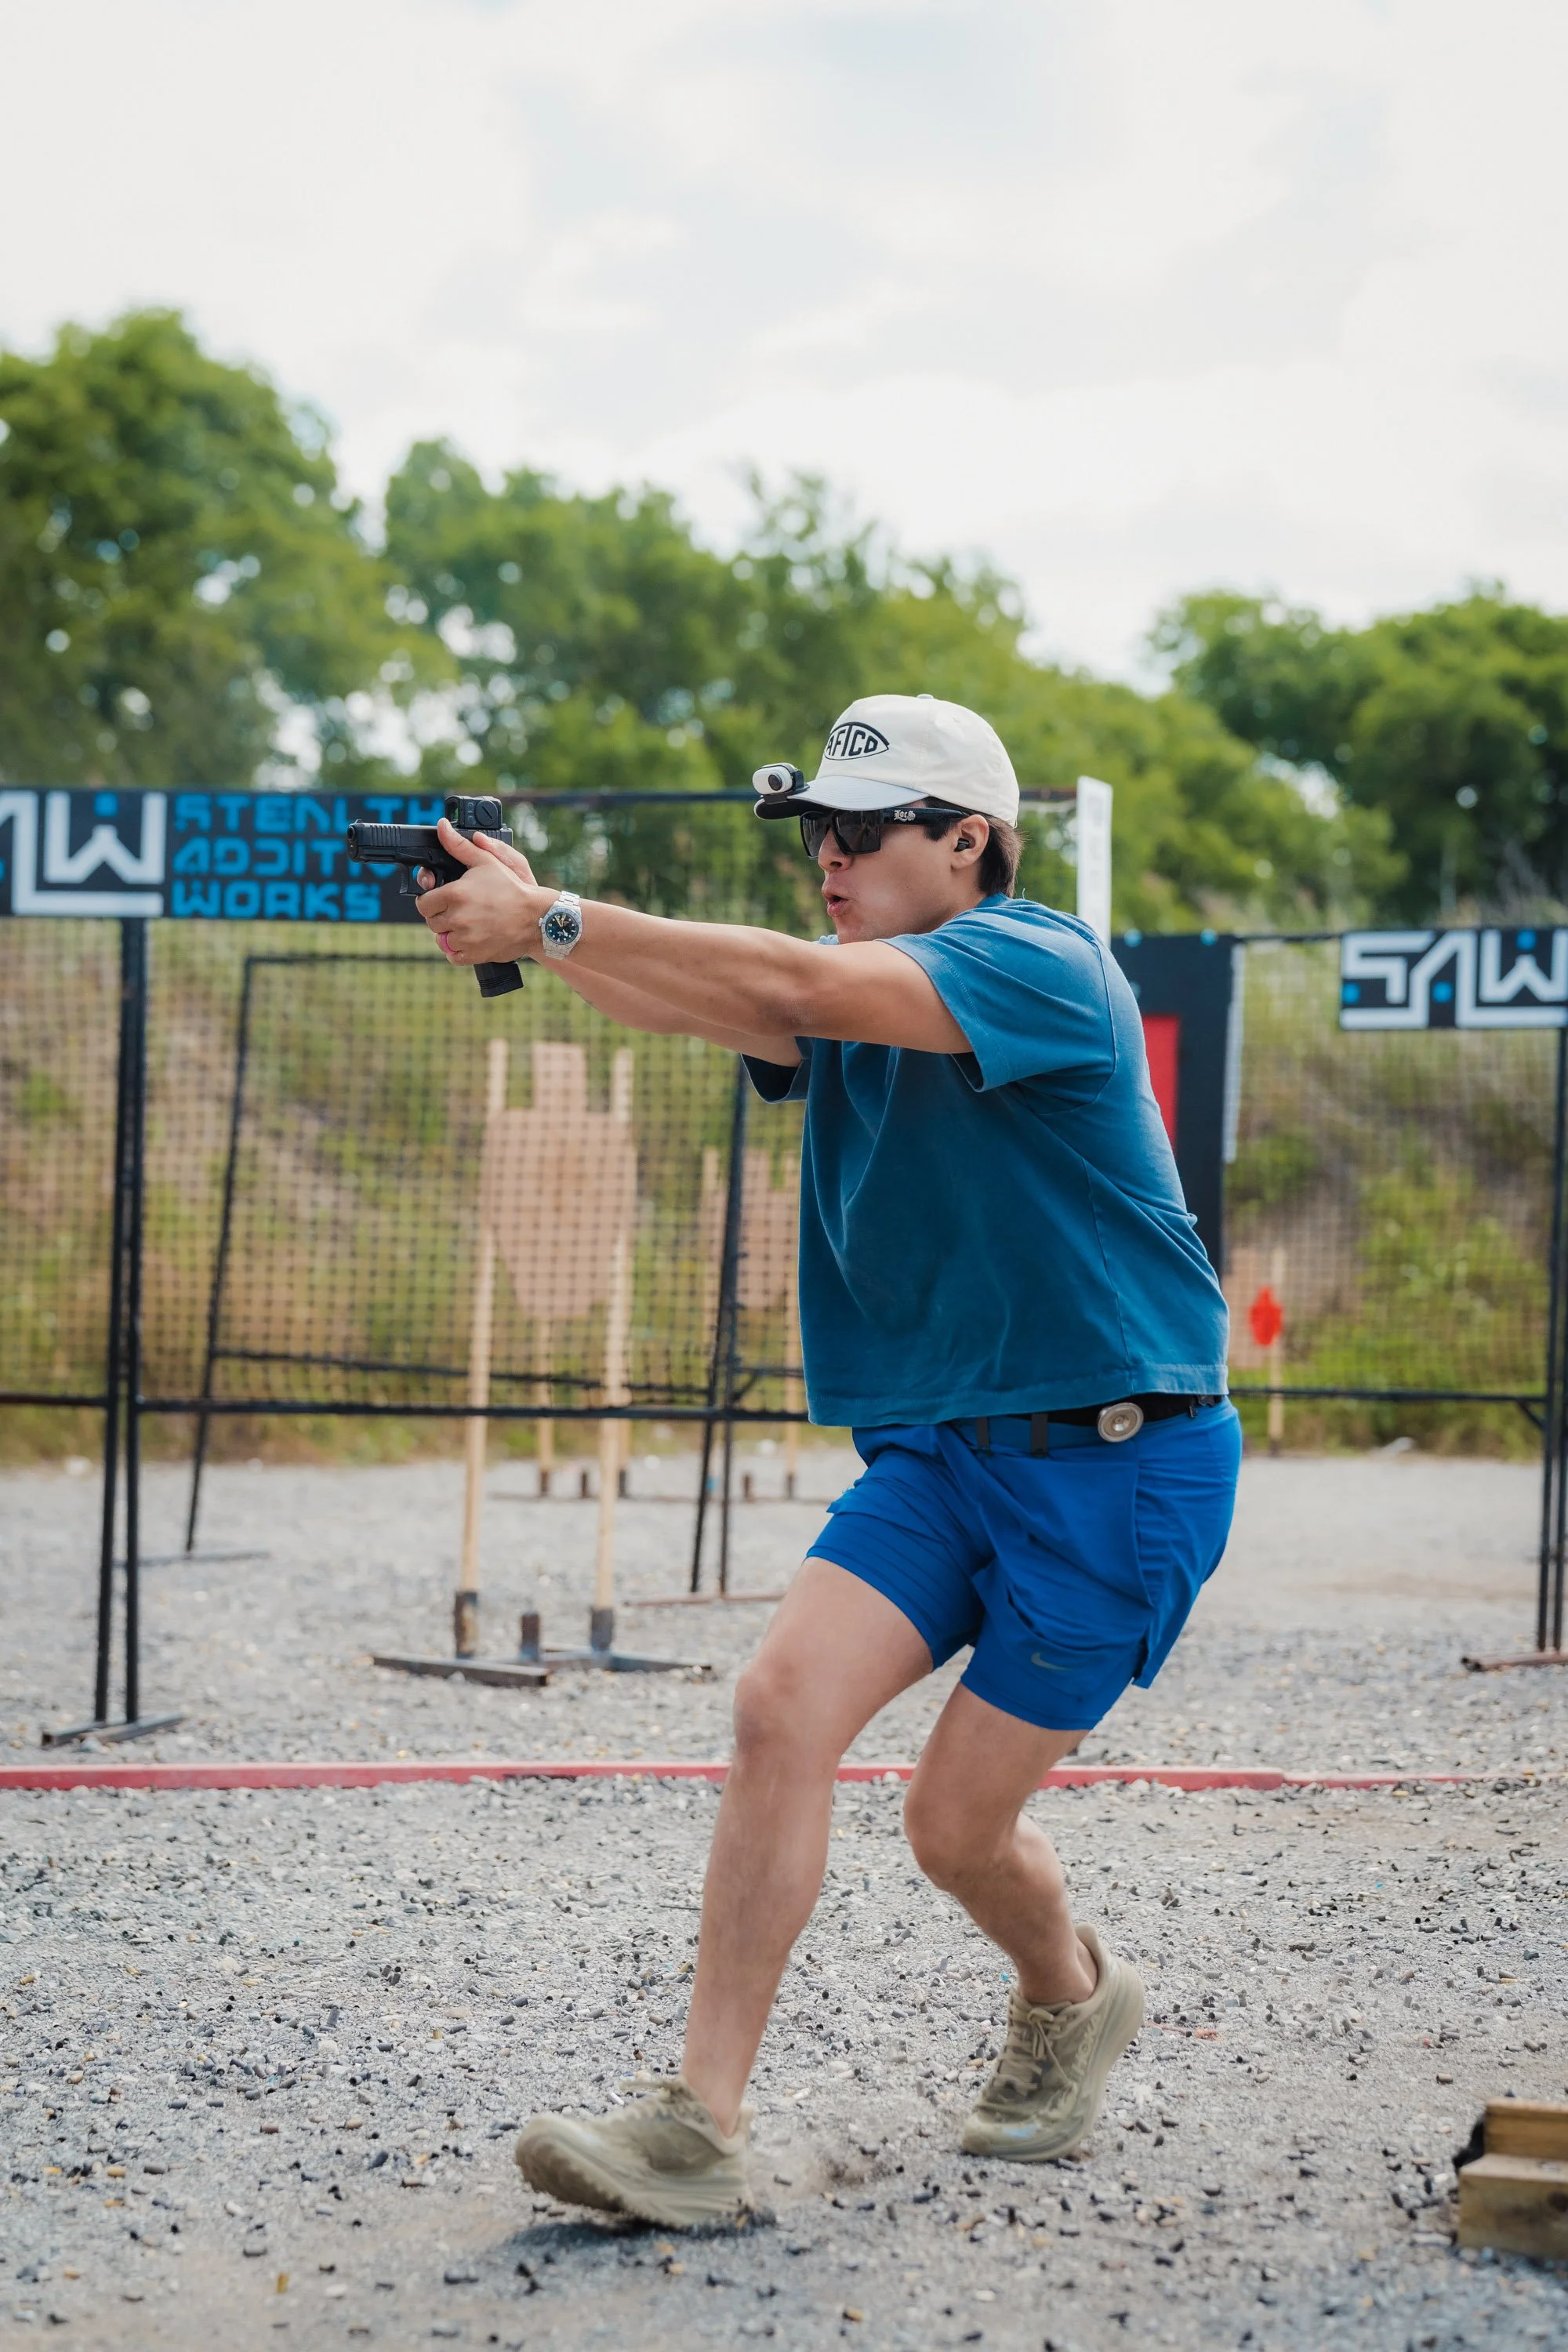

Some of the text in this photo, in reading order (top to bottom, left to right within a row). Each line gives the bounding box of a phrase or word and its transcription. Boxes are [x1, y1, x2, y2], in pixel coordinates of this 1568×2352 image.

[175, 793, 445, 834] STEALTH
[172, 837, 421, 879] ADDIT
[172, 879, 381, 921] WORKS
[1340, 929, 1568, 1029] SAW
